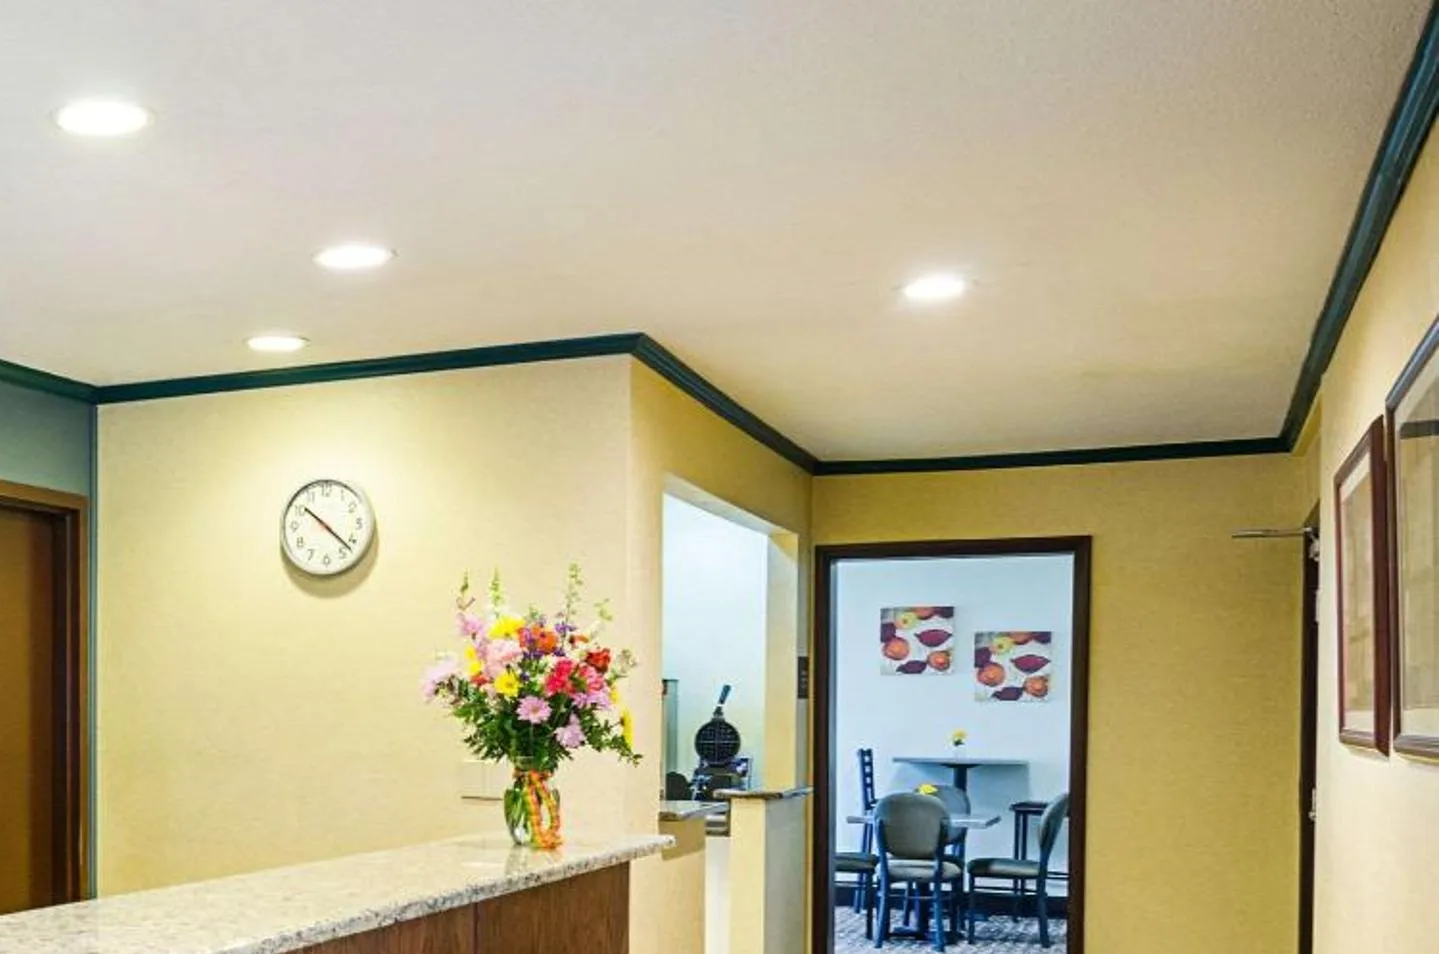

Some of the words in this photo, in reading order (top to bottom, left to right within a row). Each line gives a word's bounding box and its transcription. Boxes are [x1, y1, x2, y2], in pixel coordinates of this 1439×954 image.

[320, 484, 333, 497] 12
[307, 548, 316, 562] 7
[338, 546, 348, 559] 5
